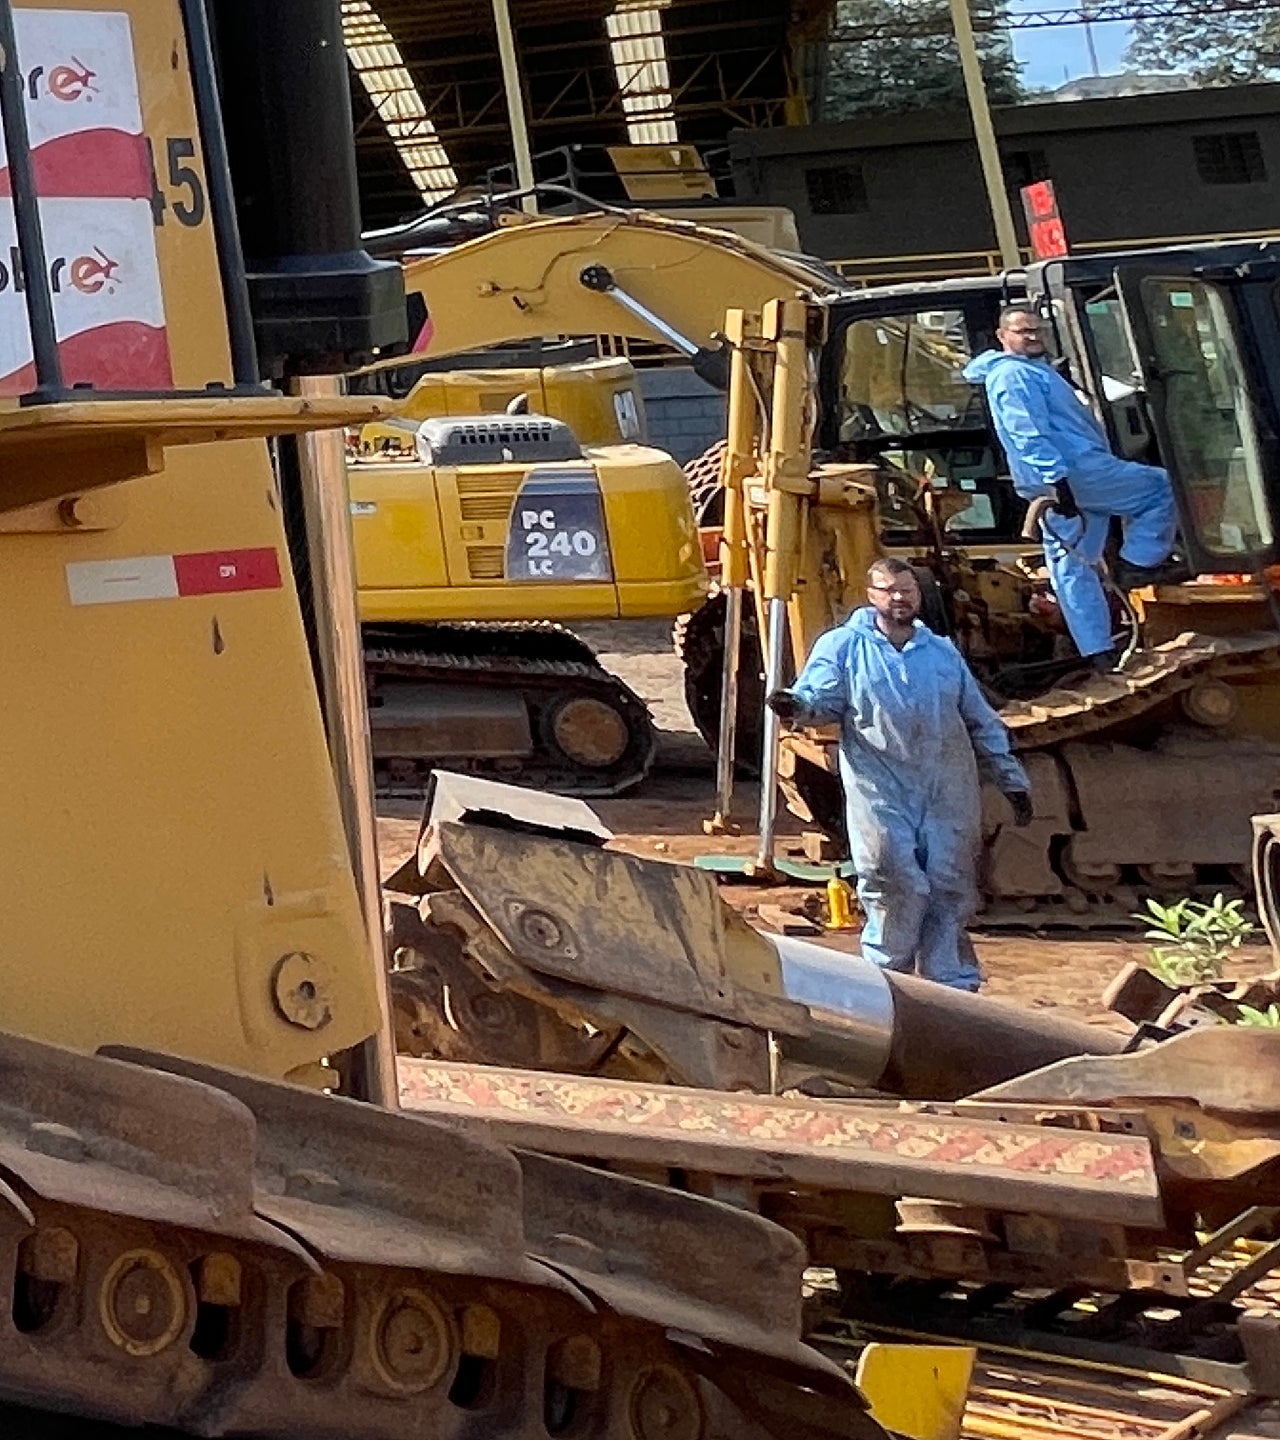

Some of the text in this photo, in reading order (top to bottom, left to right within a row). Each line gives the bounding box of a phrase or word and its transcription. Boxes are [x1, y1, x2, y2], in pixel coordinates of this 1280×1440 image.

[521, 509, 556, 530] PC
[525, 529, 597, 558] 240
[527, 559, 554, 576] LC
